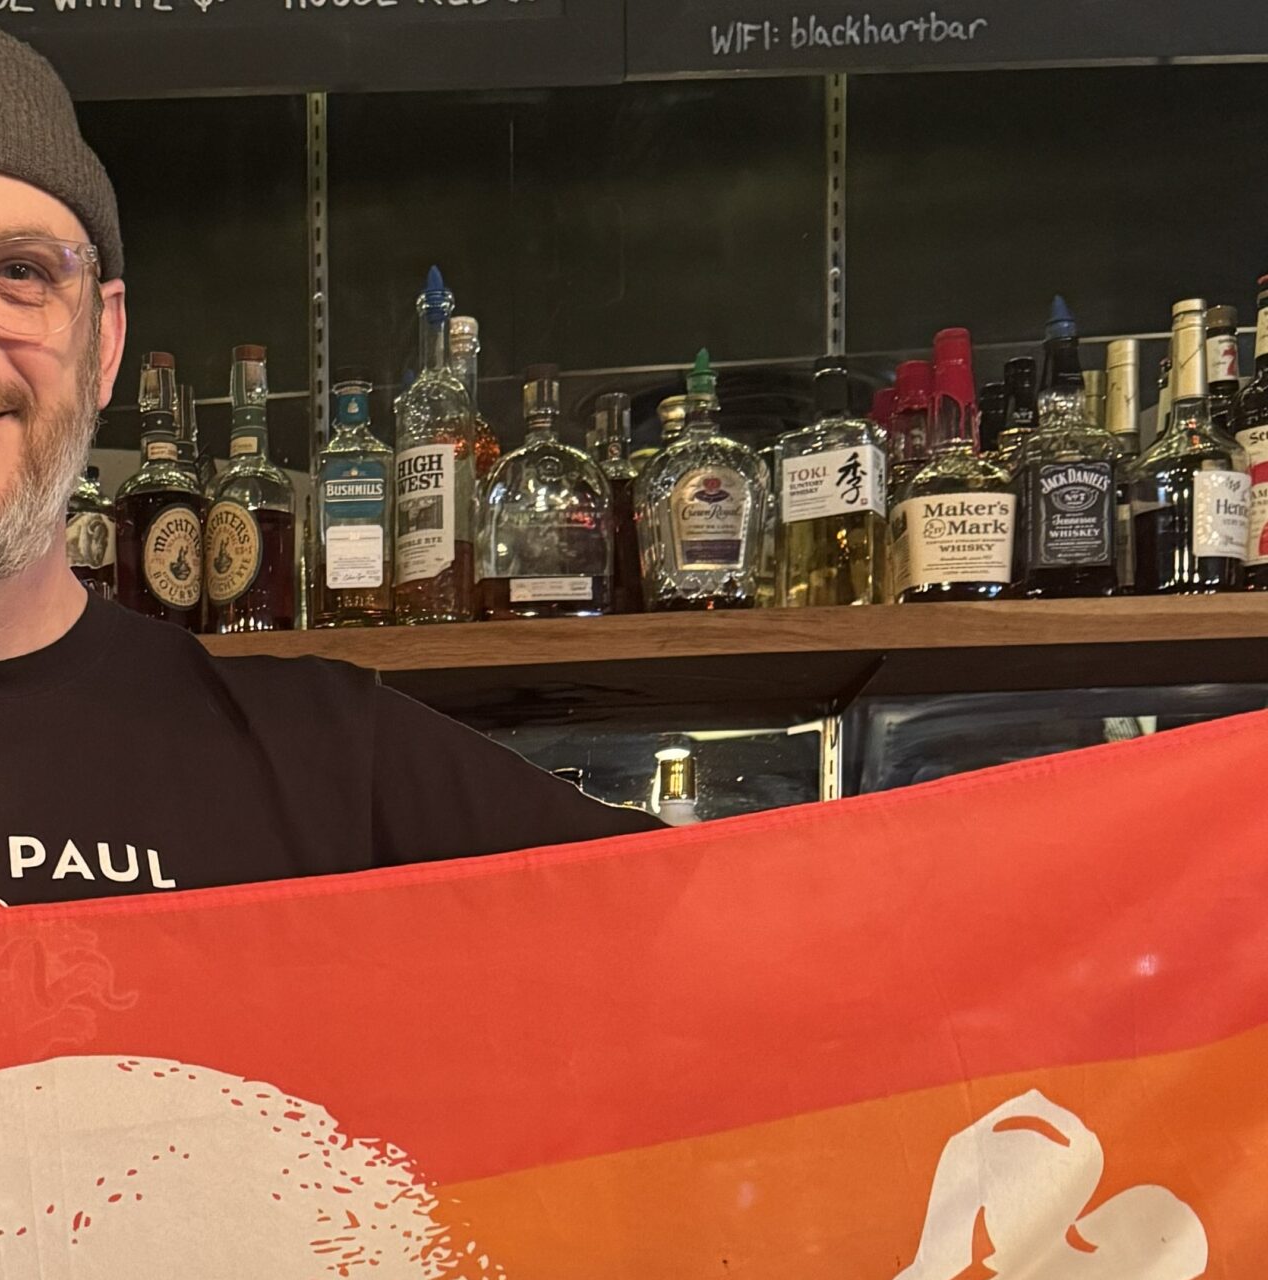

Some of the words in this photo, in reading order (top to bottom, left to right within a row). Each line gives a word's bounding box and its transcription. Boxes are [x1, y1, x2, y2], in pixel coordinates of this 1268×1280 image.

[791, 11, 987, 49] blackhartbar
[397, 453, 444, 480] HIGH
[787, 466, 828, 482] TOKI
[326, 483, 383, 497] BUSHMILLS
[397, 472, 444, 497] WEST
[1040, 473, 1070, 494] JACK
[1067, 468, 1111, 492] DANIEL'S
[682, 505, 713, 521] Crown
[708, 505, 742, 522] Royal
[922, 500, 1010, 519] Maker's
[947, 519, 1007, 536] Mark
[1049, 528, 1101, 538] WHISKEY
[153, 518, 201, 557] MICHTER
[939, 543, 995, 553] WHISKY
[8, 835, 177, 889] PAUL
